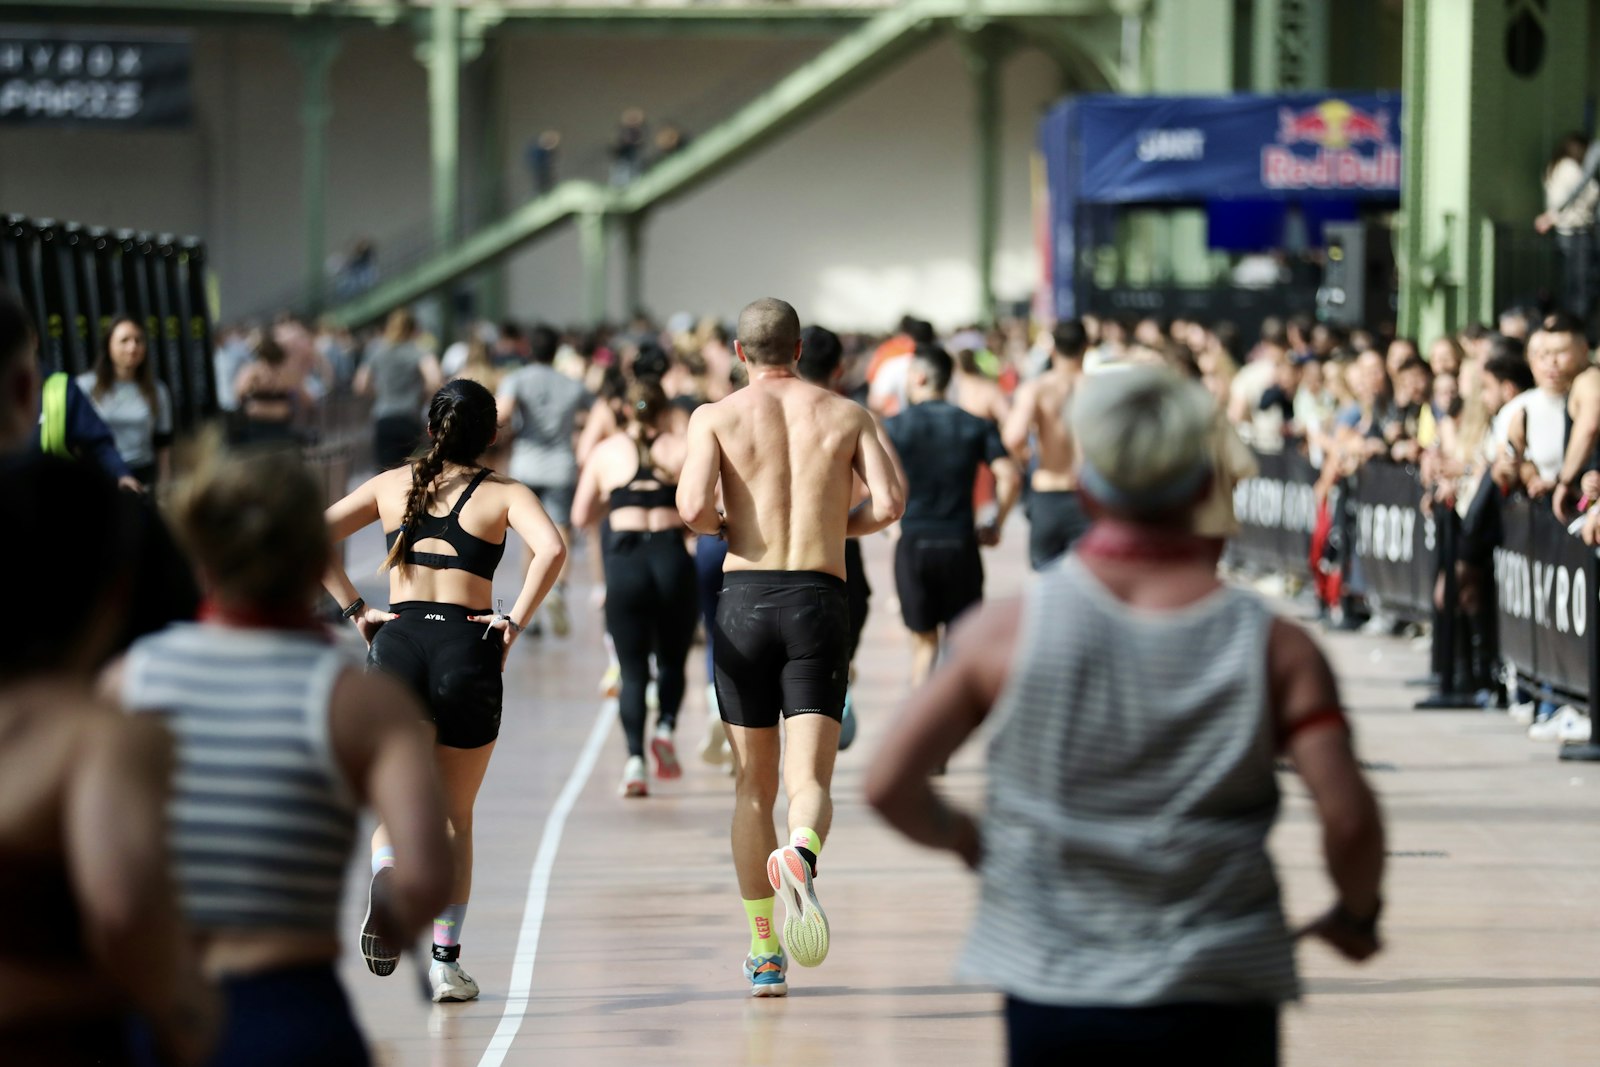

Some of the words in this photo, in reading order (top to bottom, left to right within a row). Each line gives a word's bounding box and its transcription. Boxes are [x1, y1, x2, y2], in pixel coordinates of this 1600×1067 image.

[1262, 146, 1335, 189] Red
[1338, 146, 1400, 190] Bull
[424, 613, 446, 621] AYBL
[755, 916, 770, 939] KEEP
